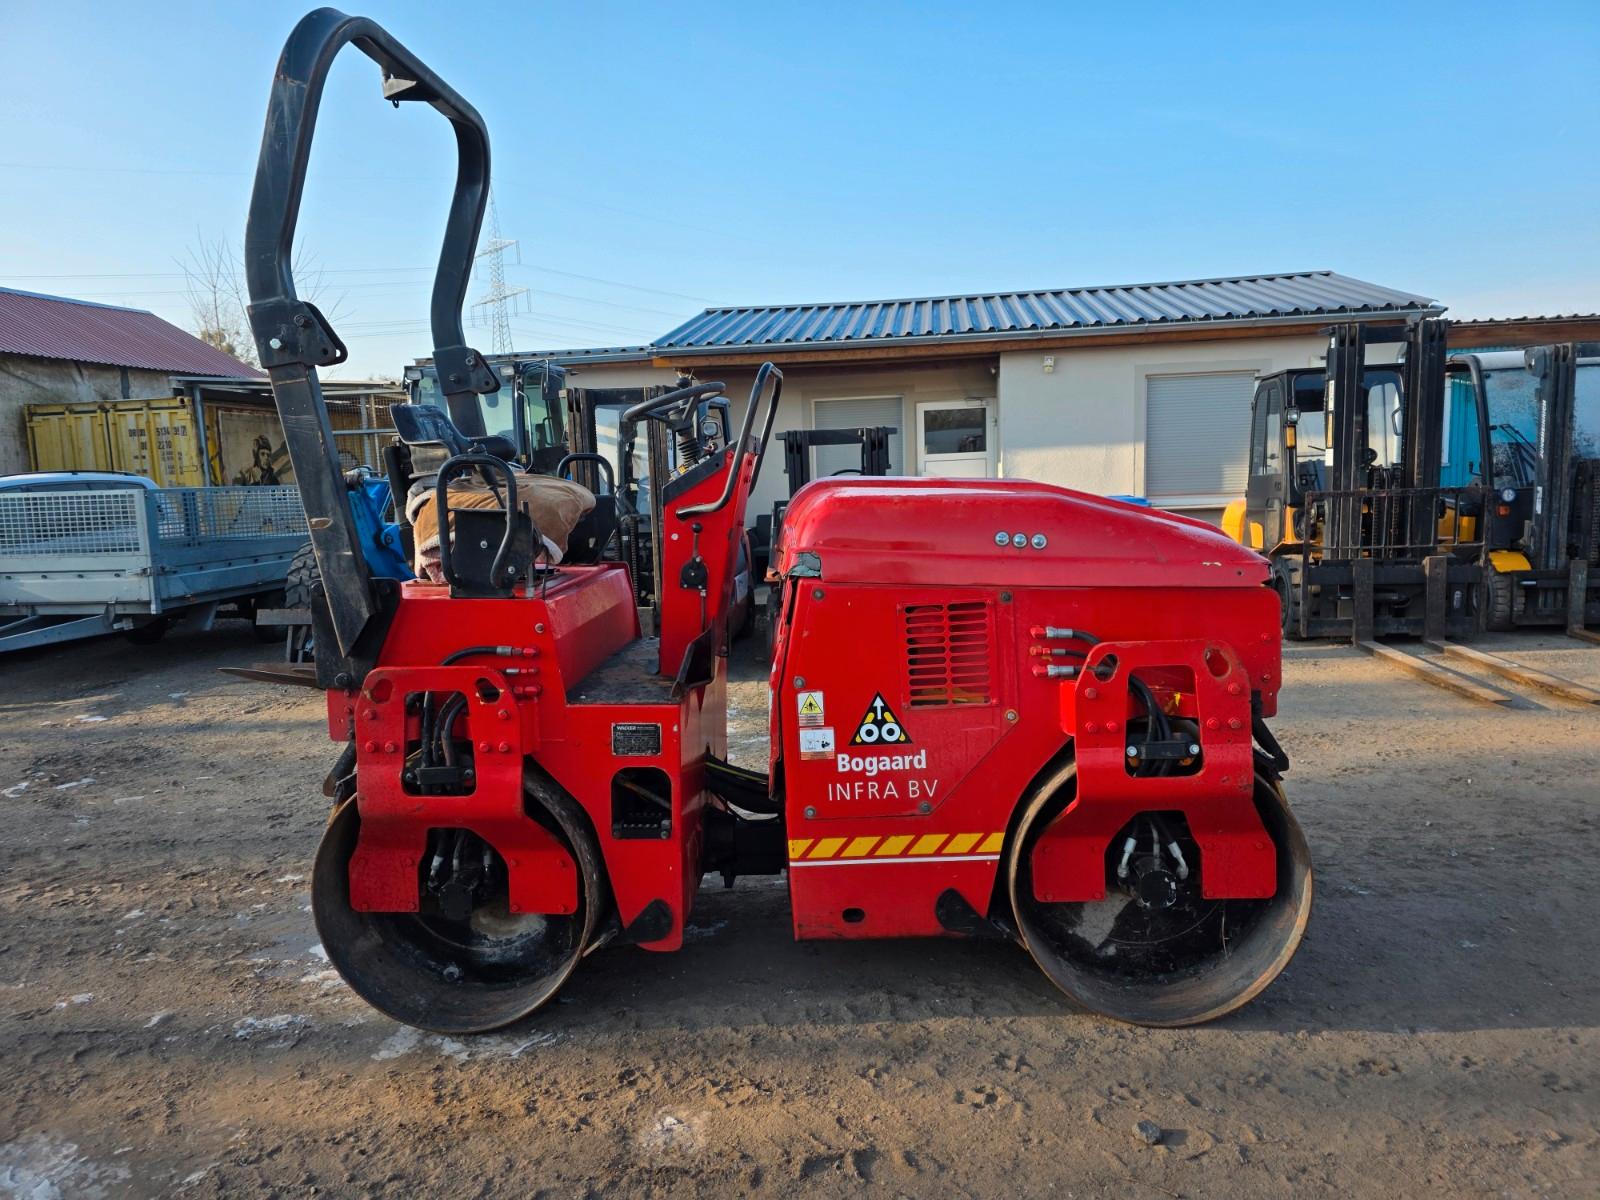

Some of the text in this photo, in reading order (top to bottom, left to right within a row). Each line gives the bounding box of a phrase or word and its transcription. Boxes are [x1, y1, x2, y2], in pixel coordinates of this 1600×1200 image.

[836, 749, 927, 776] Bogaard
[828, 779, 938, 801] INFRA BV
